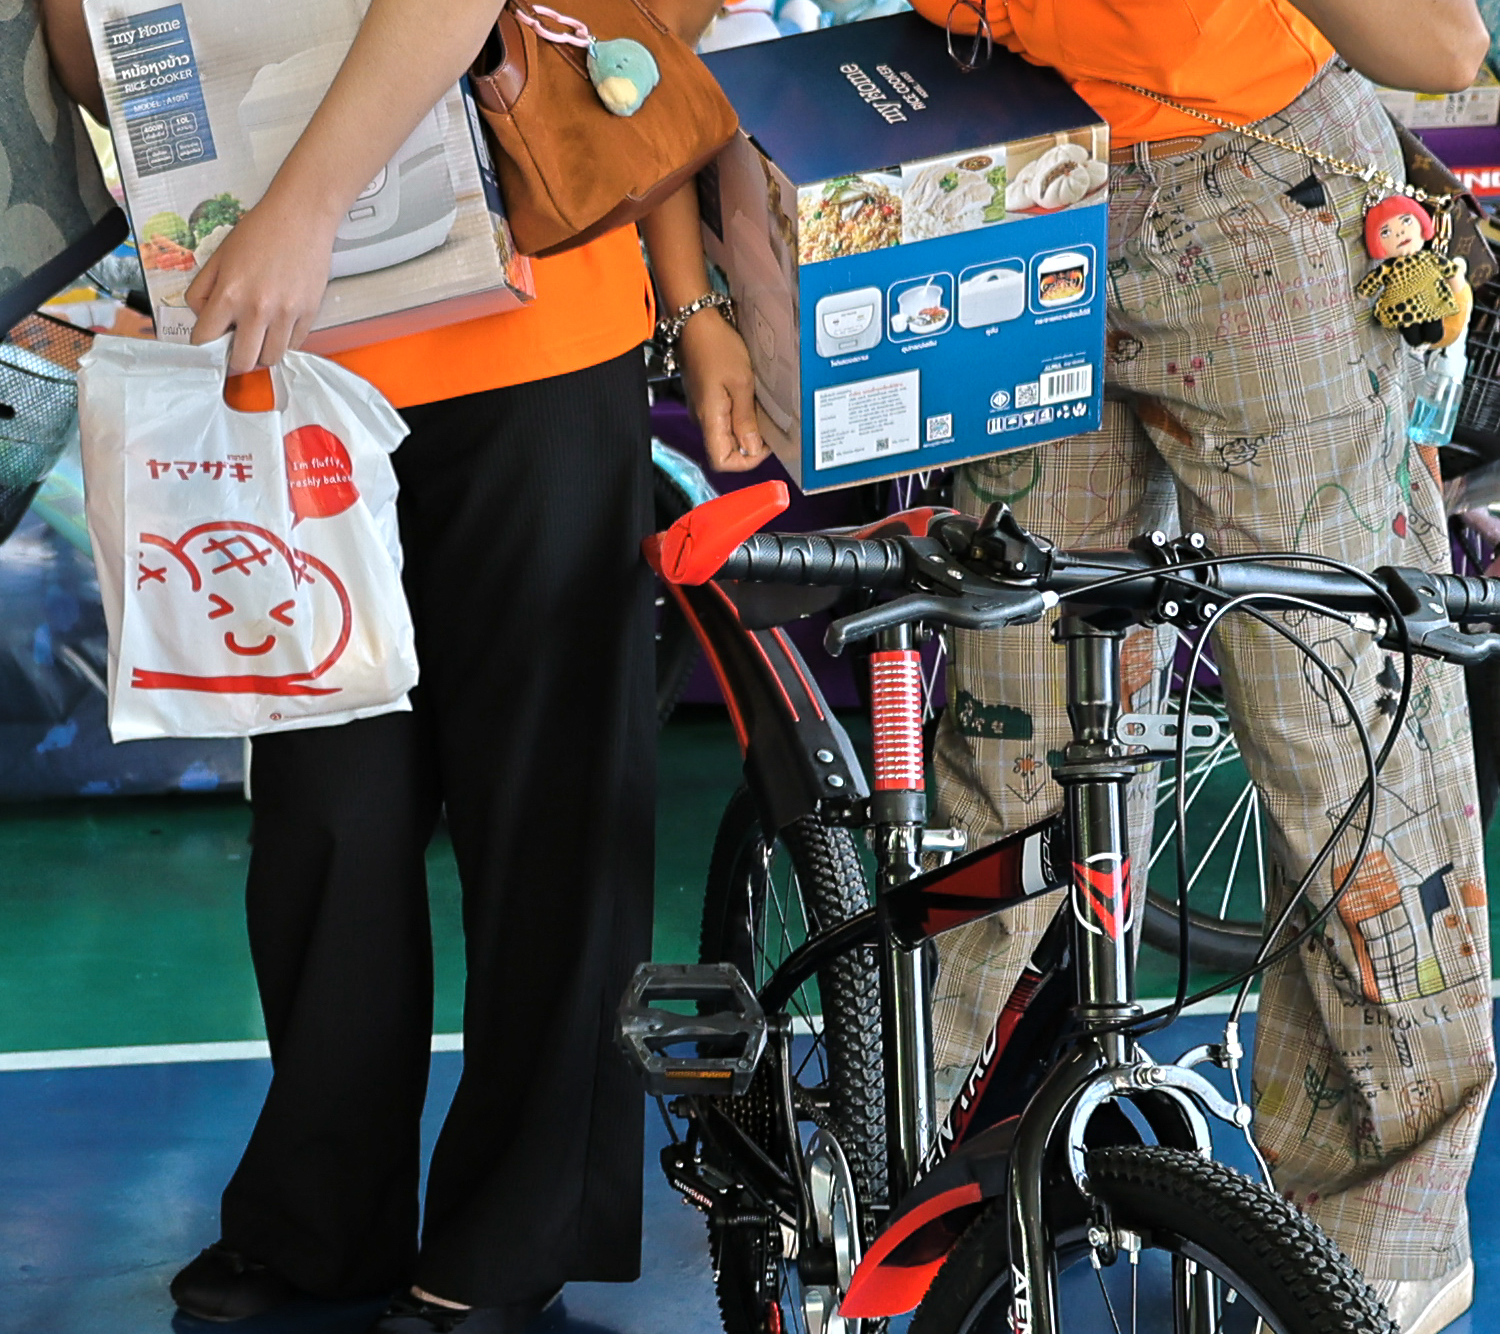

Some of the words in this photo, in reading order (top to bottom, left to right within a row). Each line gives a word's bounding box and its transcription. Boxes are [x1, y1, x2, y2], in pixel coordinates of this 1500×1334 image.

[111, 29, 136, 45] my
[138, 18, 181, 40] Home
[121, 54, 190, 81] หม้อหุงข้าว
[875, 64, 910, 95] COOKER
[125, 81, 147, 94] RICE
[149, 69, 193, 89] COOKER
[839, 62, 887, 104] Home
[133, 98, 162, 113] MODEL
[872, 100, 907, 125] my
[292, 458, 309, 471] I'm
